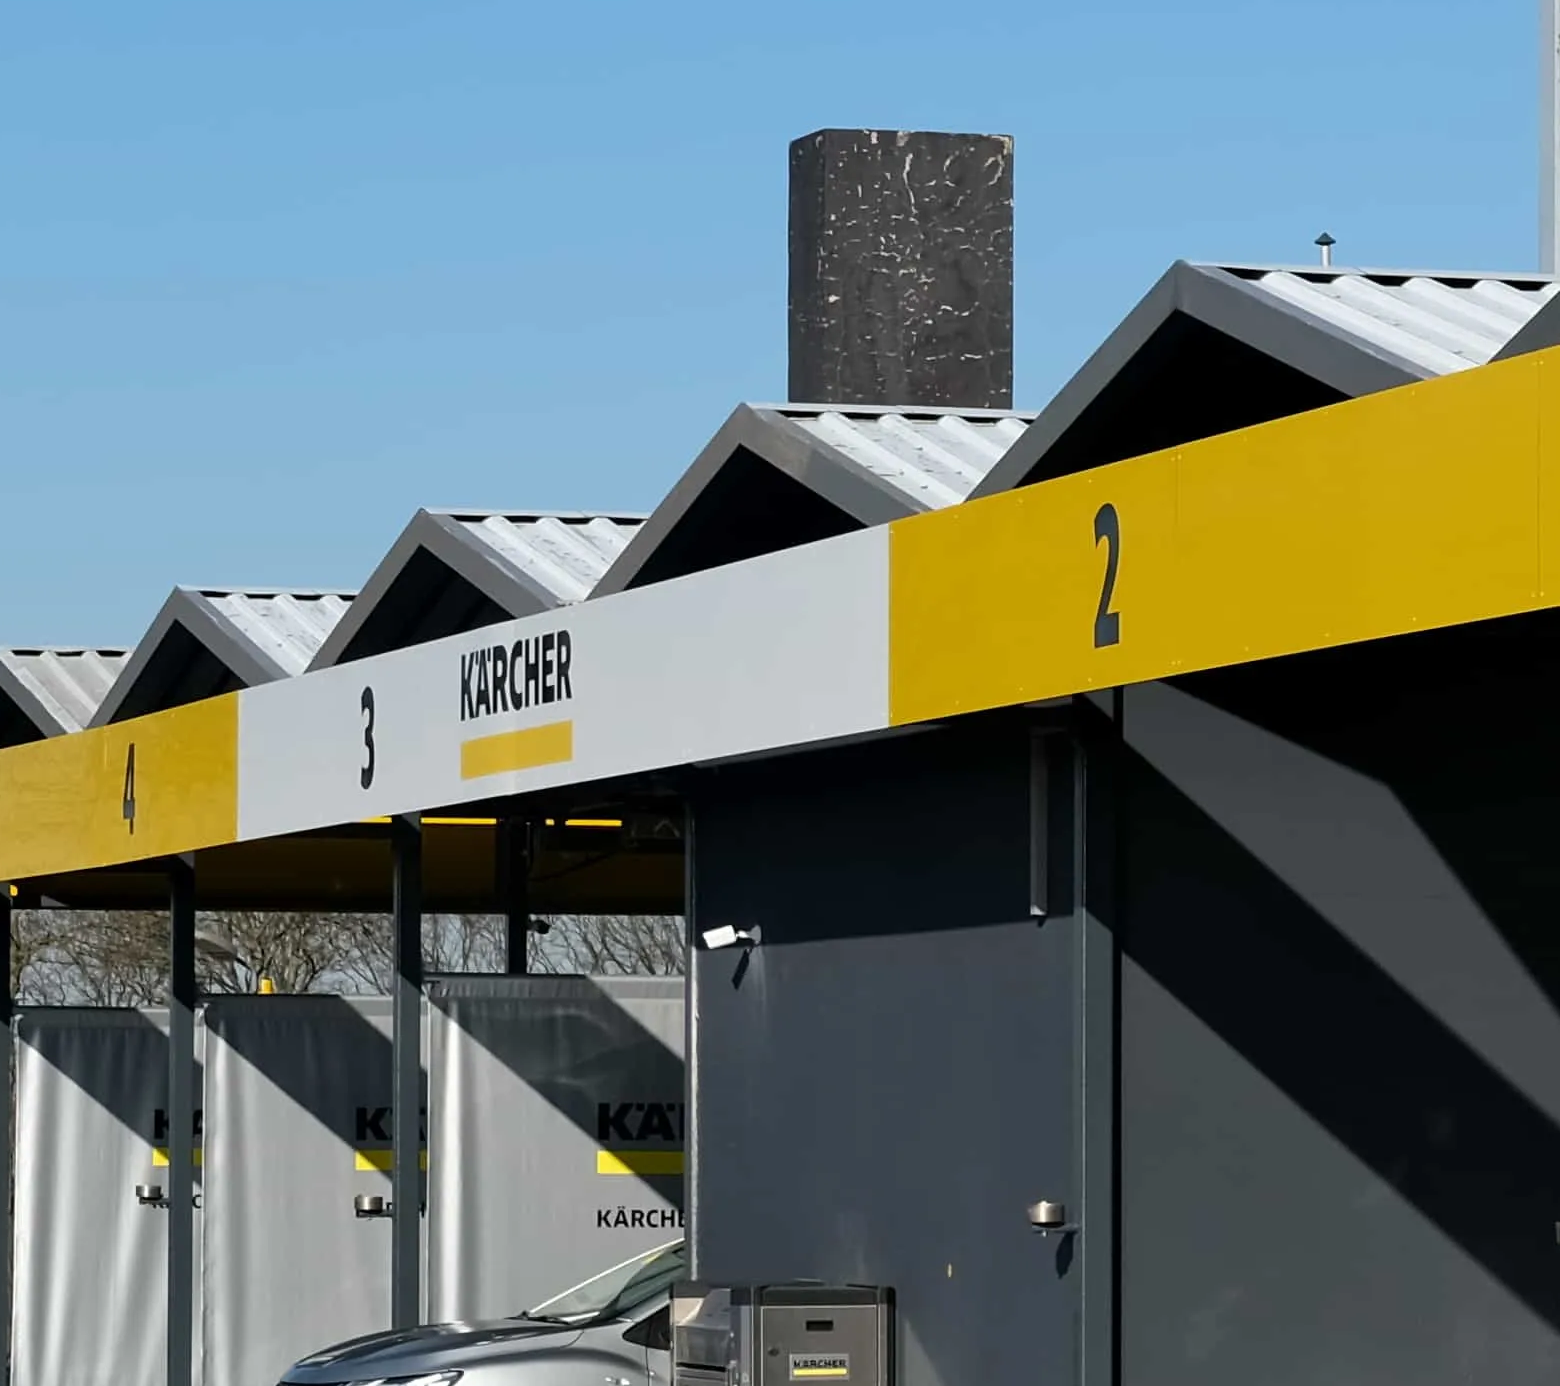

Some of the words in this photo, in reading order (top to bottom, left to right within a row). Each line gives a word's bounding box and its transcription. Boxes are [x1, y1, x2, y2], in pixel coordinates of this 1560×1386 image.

[1093, 503, 1120, 649] 2
[460, 629, 572, 721] KÄRCHER
[360, 686, 375, 790] 3
[122, 742, 136, 835] 4
[597, 1205, 684, 1229] KÄRCH
